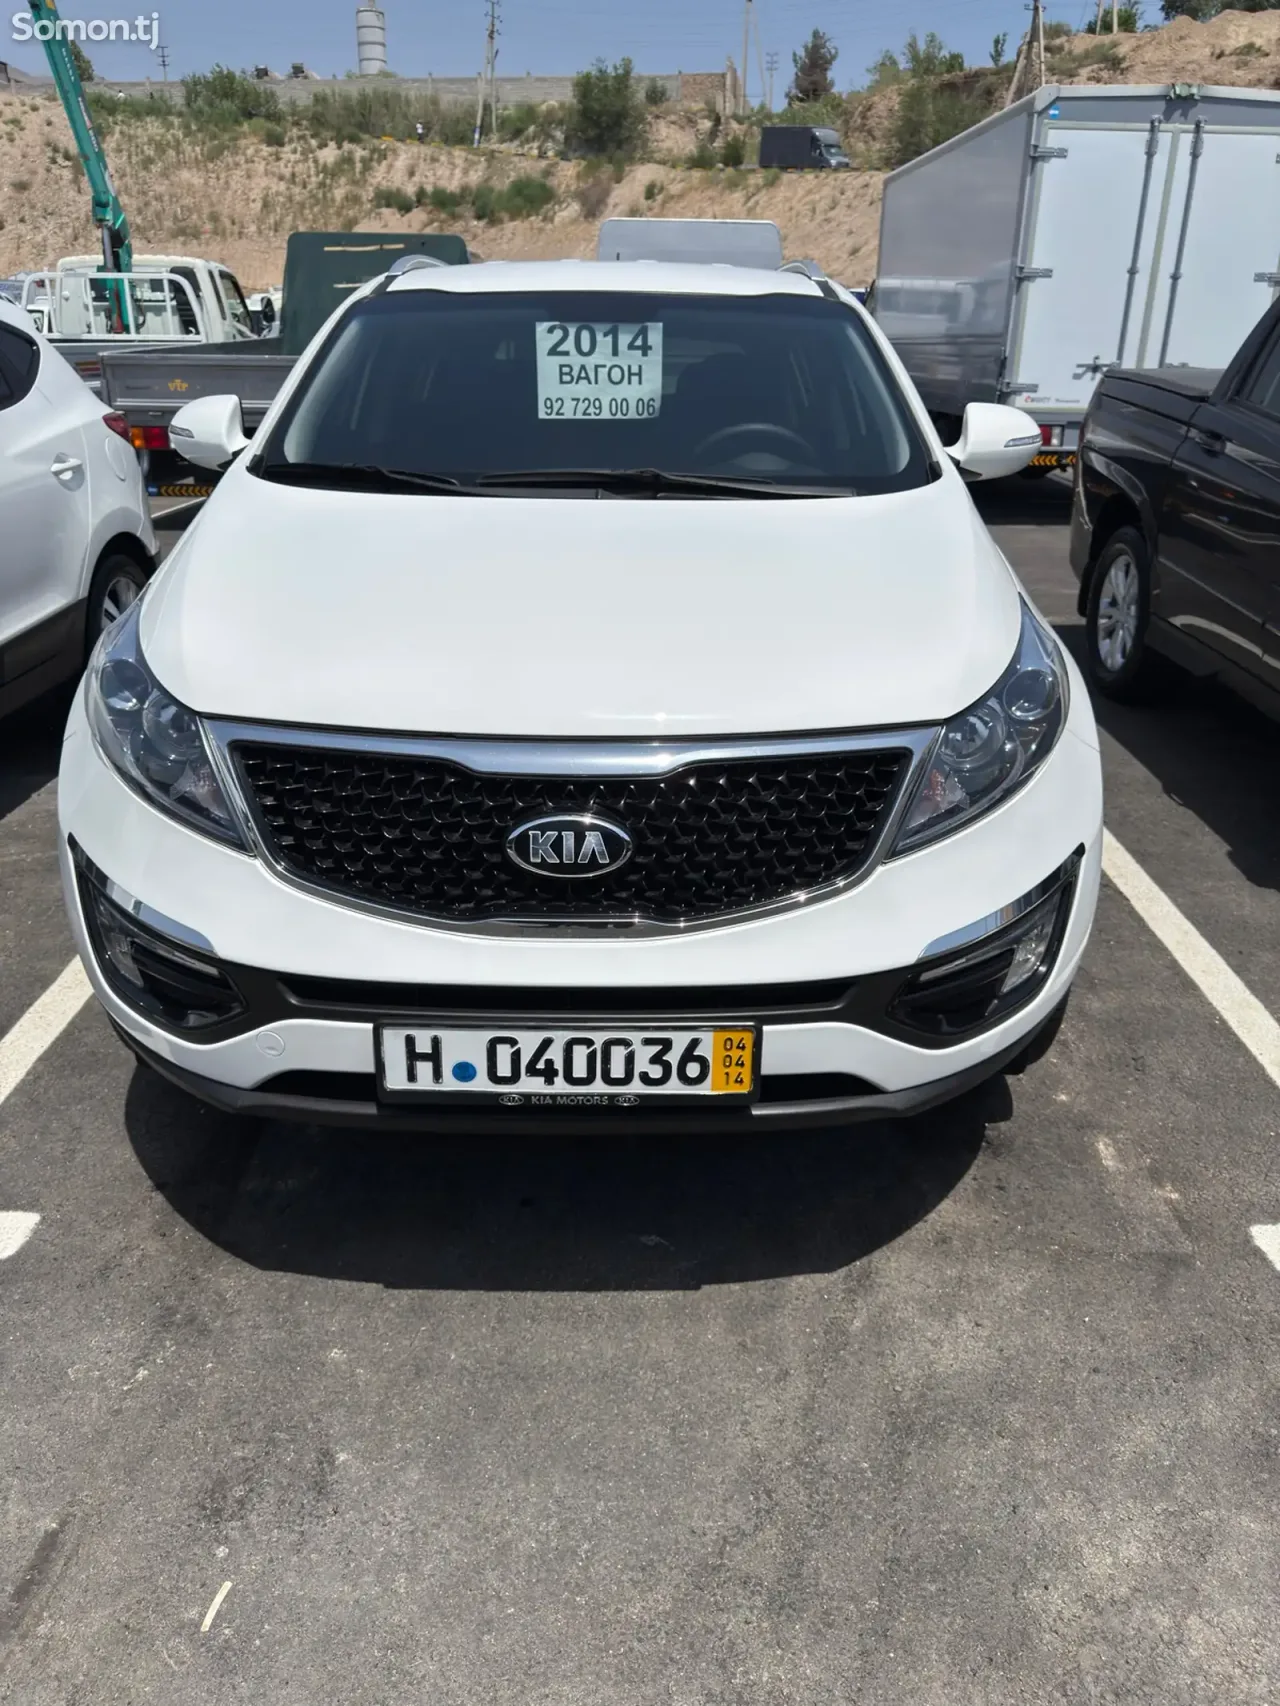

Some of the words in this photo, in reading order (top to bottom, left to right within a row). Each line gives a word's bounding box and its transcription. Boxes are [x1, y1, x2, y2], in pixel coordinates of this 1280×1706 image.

[546, 324, 653, 357] 2014
[558, 364, 642, 385] ВАГОН
[544, 397, 565, 416] 92
[571, 398, 602, 416] 729
[609, 398, 629, 417] 00
[636, 398, 656, 416] 06
[528, 831, 610, 863] KIA
[723, 1037, 746, 1051] 04
[404, 1033, 443, 1084] H
[486, 1035, 710, 1087] 040036
[722, 1055, 745, 1068] 04
[724, 1072, 744, 1085] 14
[531, 1096, 552, 1104] KIA
[556, 1096, 609, 1104] MOTORS
